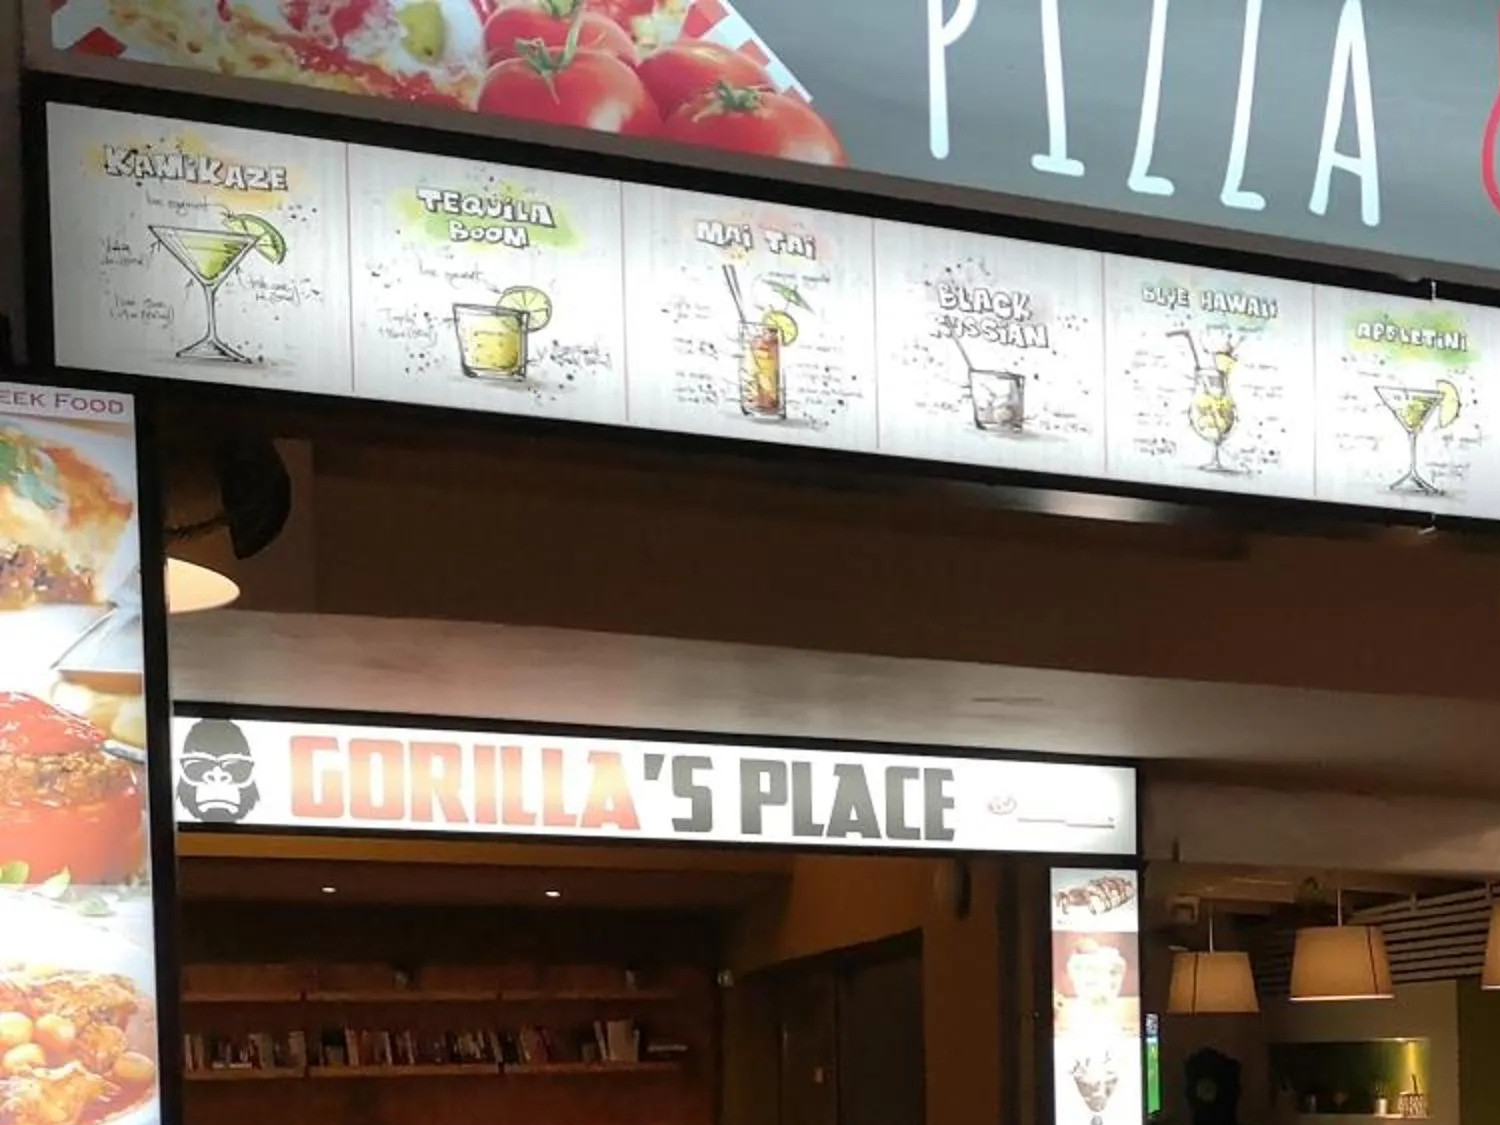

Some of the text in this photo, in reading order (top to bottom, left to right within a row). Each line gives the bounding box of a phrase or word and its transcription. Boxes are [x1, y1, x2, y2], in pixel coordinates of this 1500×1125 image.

[928, 0, 1380, 227] PIZZA
[938, 284, 1033, 322] BLACK
[1141, 285, 1190, 309] BLUE
[289, 734, 956, 842] GORILLA'S PLACE
